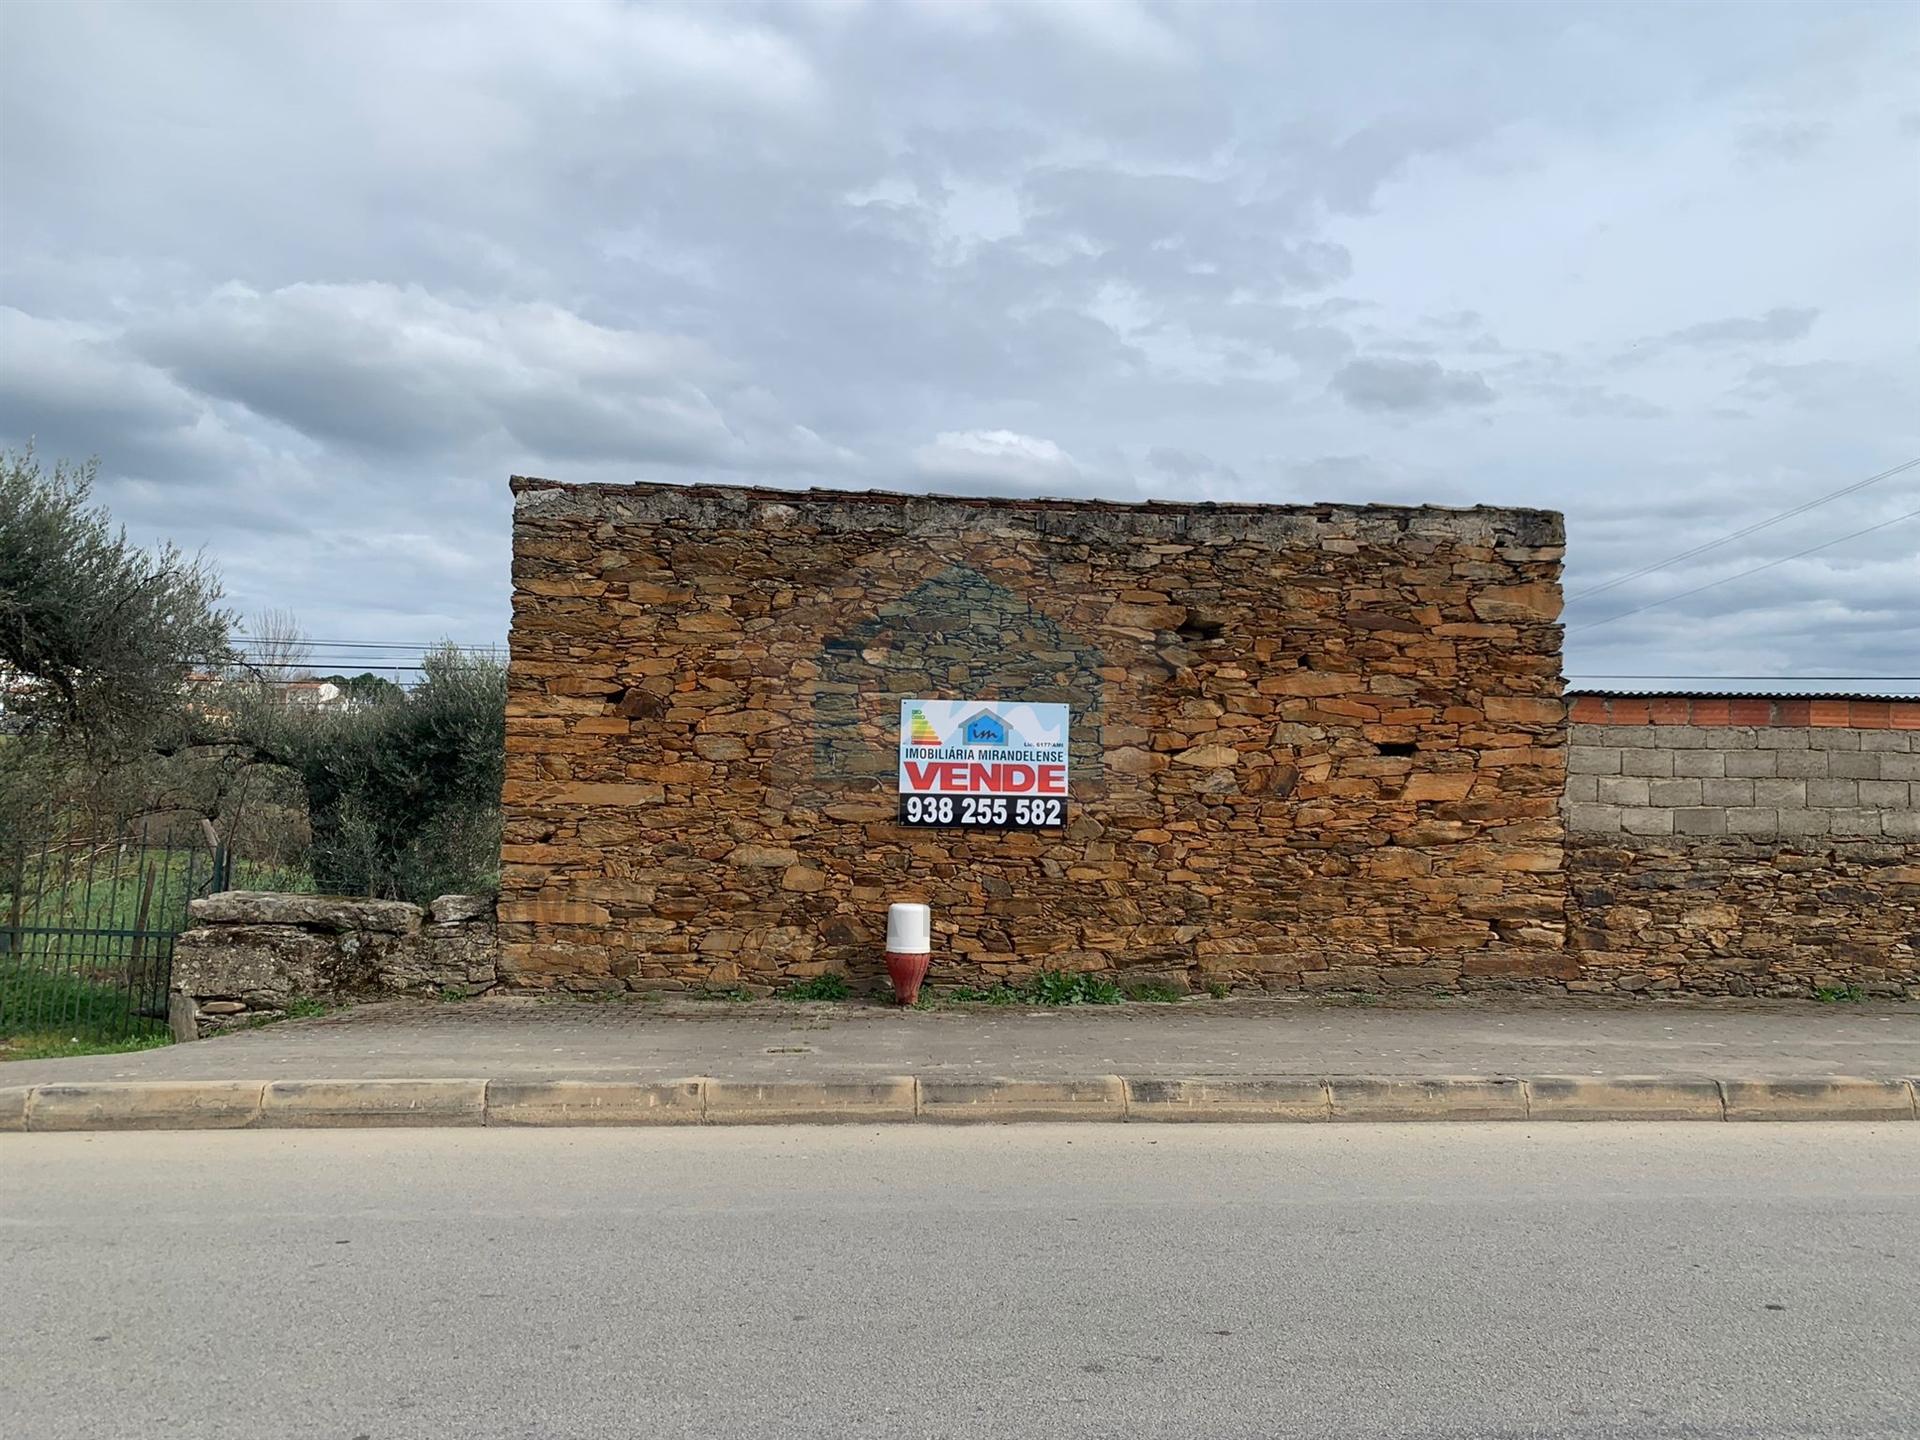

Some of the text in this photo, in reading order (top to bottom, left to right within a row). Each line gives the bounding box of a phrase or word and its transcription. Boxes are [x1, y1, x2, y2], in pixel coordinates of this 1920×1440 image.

[905, 746, 1064, 762] IMOBILIÁRIA MIRANDELENSE
[903, 762, 1066, 793] VENDE
[907, 797, 1060, 825] 938 255 582
